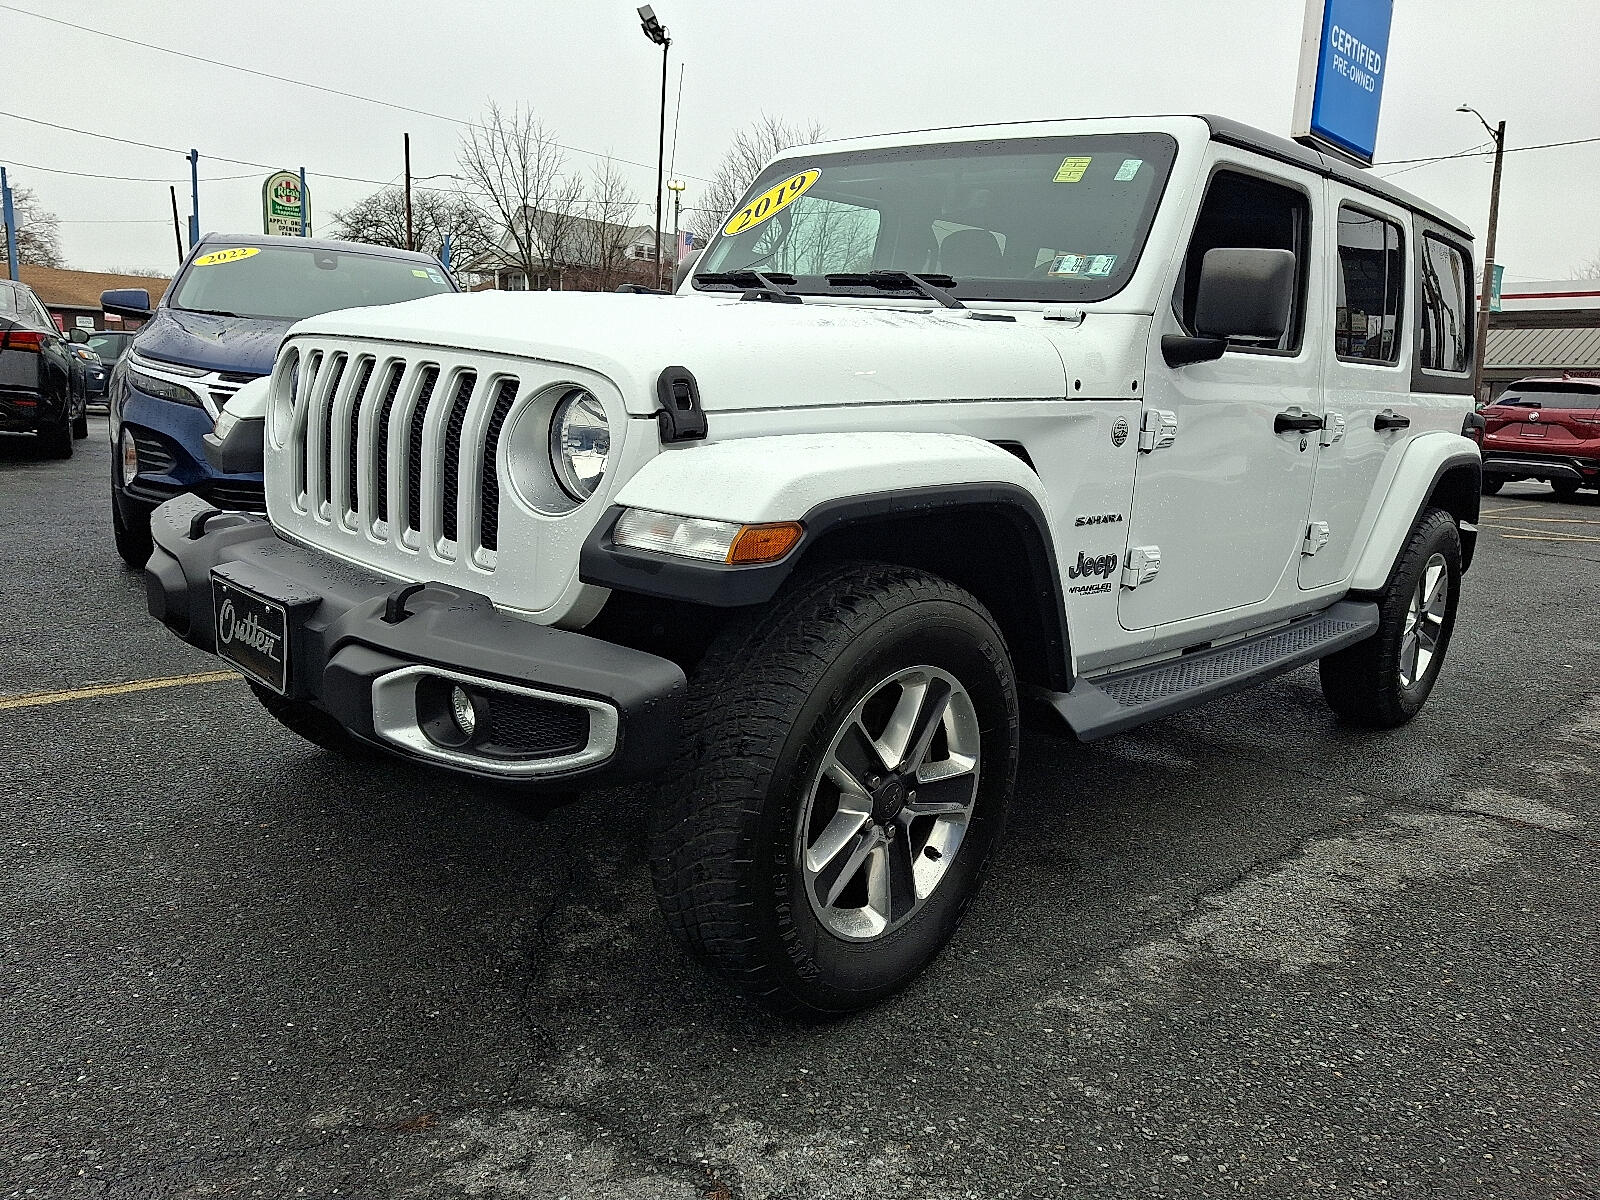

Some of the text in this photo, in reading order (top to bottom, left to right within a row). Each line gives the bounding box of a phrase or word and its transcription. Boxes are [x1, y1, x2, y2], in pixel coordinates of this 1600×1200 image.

[1331, 24, 1382, 75] CERTIFIED
[1332, 53, 1375, 93] PRE-OWNED
[736, 175, 807, 232] 2019
[269, 217, 288, 225] APPLY
[207, 248, 248, 264] 2022
[1074, 513, 1124, 527] SAHARA
[1068, 550, 1118, 580] Jeep
[1068, 582, 1112, 594] WRANGLER
[219, 598, 282, 663] Outten
